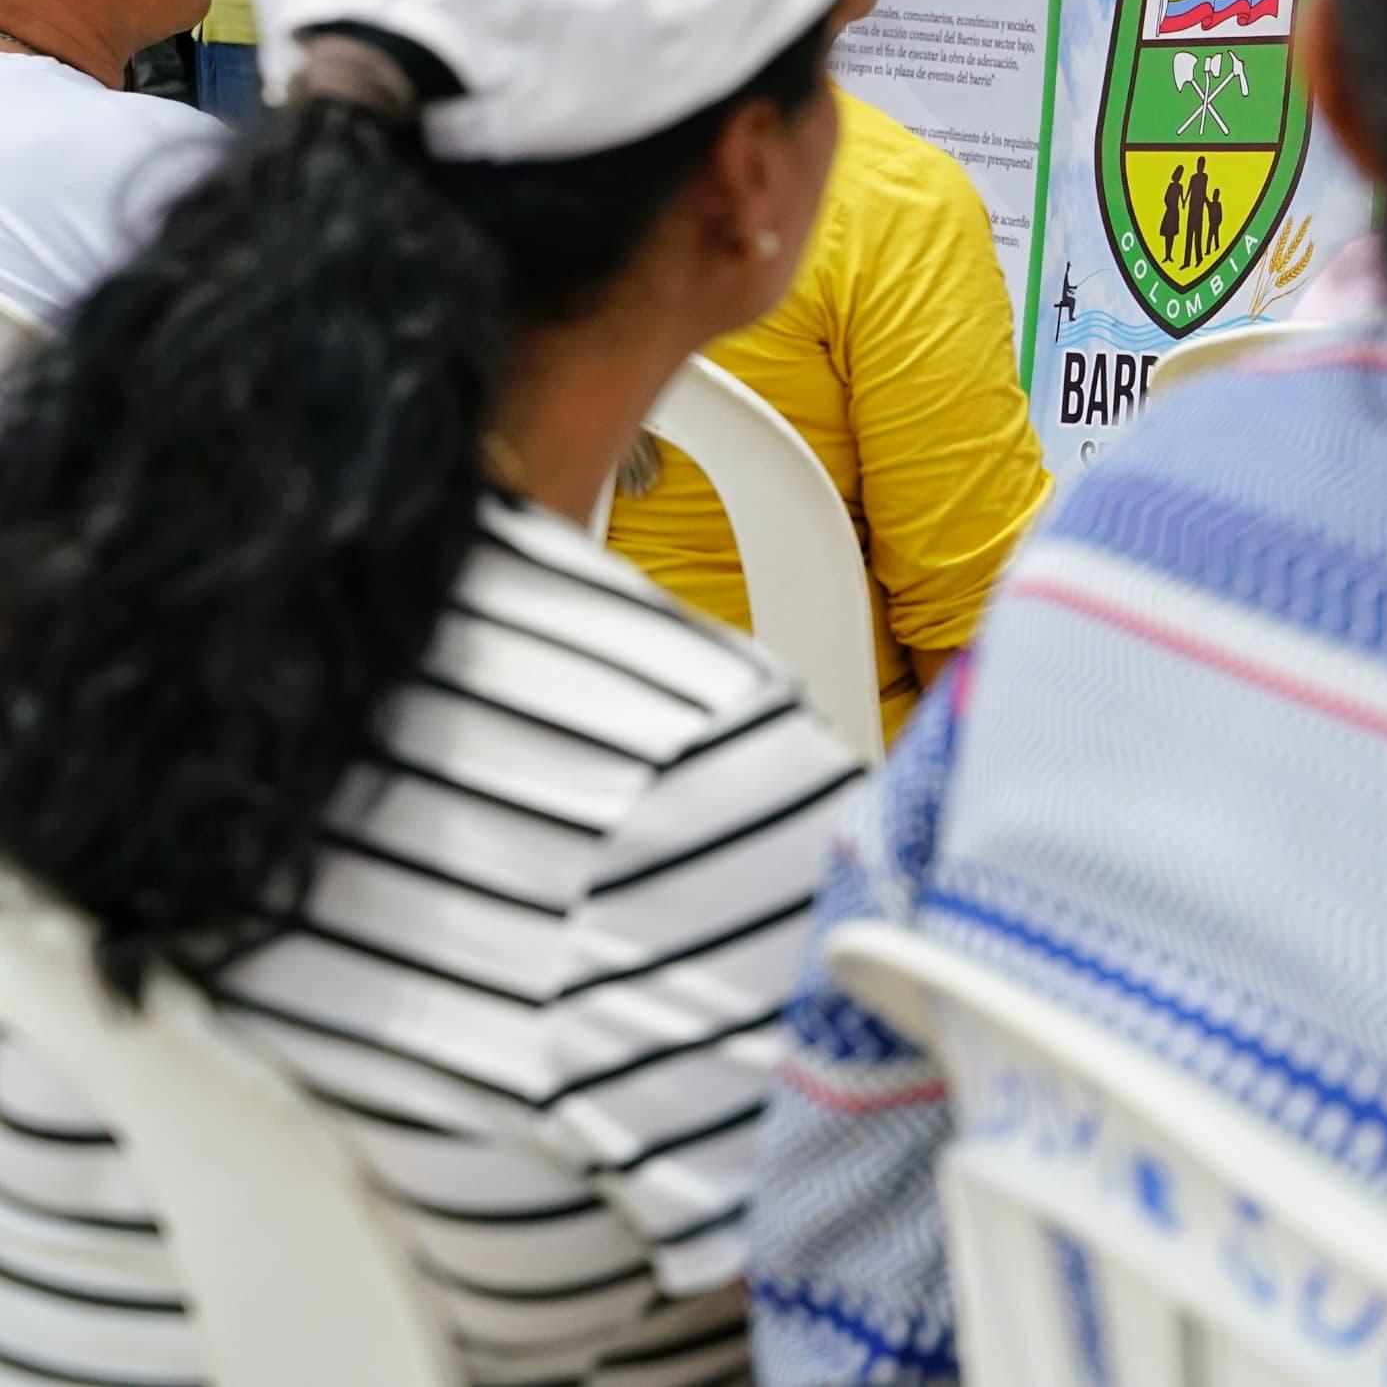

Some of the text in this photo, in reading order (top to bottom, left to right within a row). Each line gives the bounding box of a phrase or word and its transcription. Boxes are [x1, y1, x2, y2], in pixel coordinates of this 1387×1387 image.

[871, 23, 880, 37] de
[943, 29, 955, 44] del
[876, 43, 883, 56] el
[897, 45, 906, 58] de
[940, 49, 946, 62] la
[967, 52, 975, 65] de
[886, 63, 893, 75] la
[916, 66, 926, 80] de
[956, 70, 968, 84] del
[982, 132, 991, 144] de
[992, 133, 1002, 146] los
[1121, 231, 1259, 319] COLOMBIA
